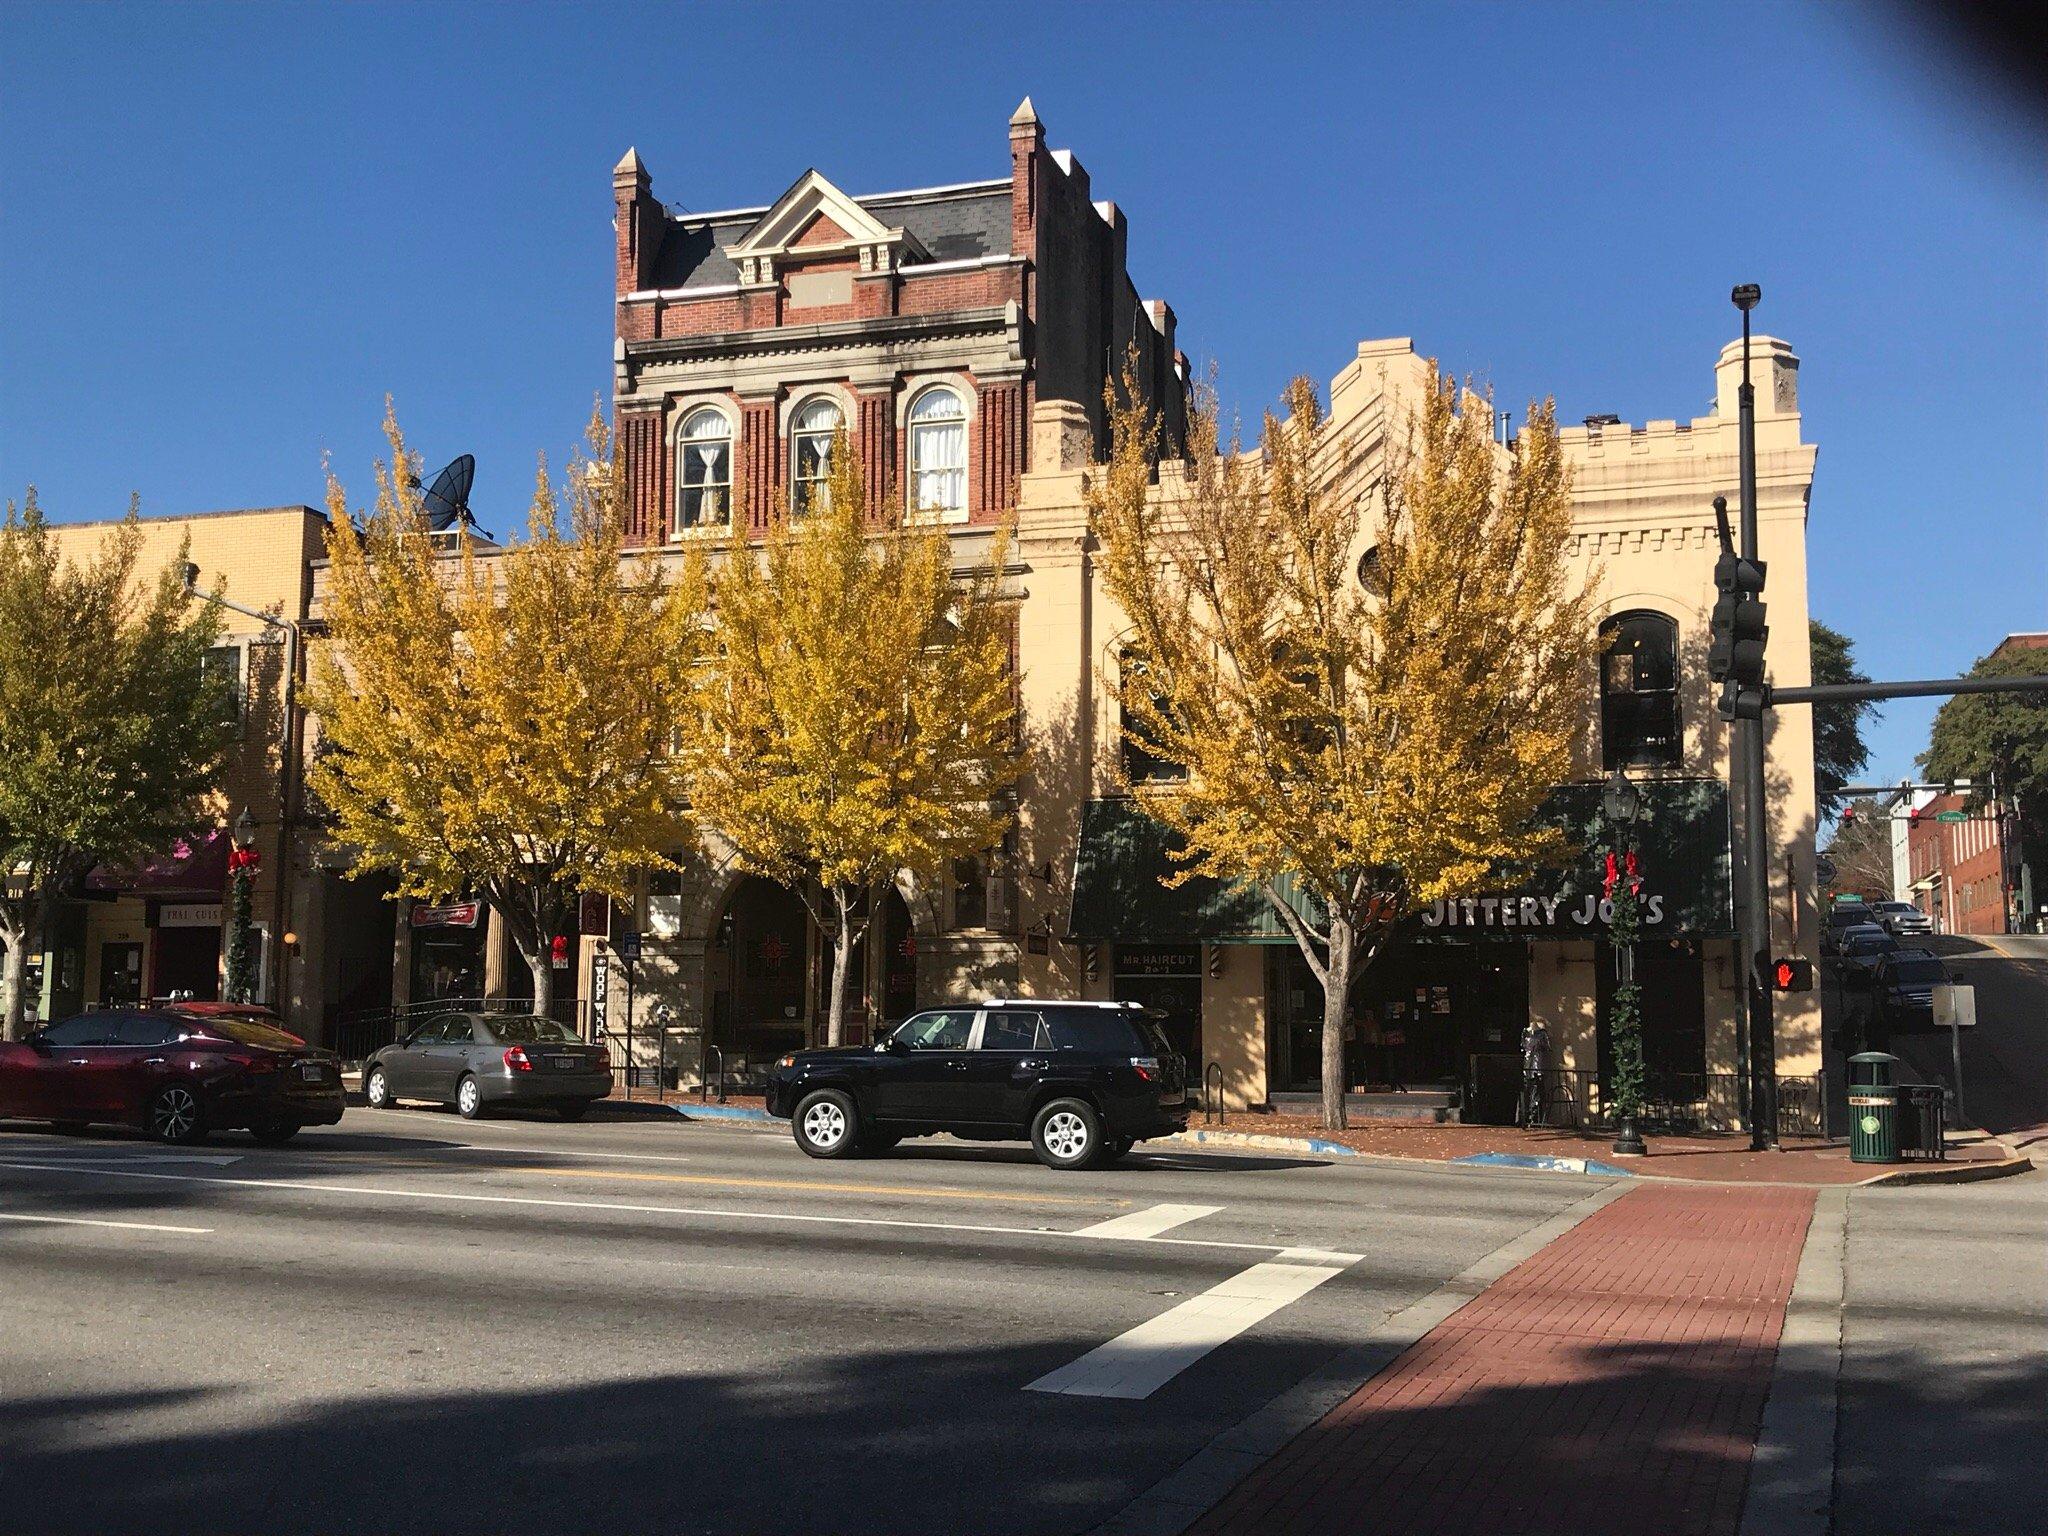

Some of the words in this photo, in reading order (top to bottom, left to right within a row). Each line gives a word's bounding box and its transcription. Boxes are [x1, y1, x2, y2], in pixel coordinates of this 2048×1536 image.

[1421, 895, 1567, 927] JITTERY
[1571, 894, 1663, 926] JO'S
[594, 966, 607, 1001] WOOF
